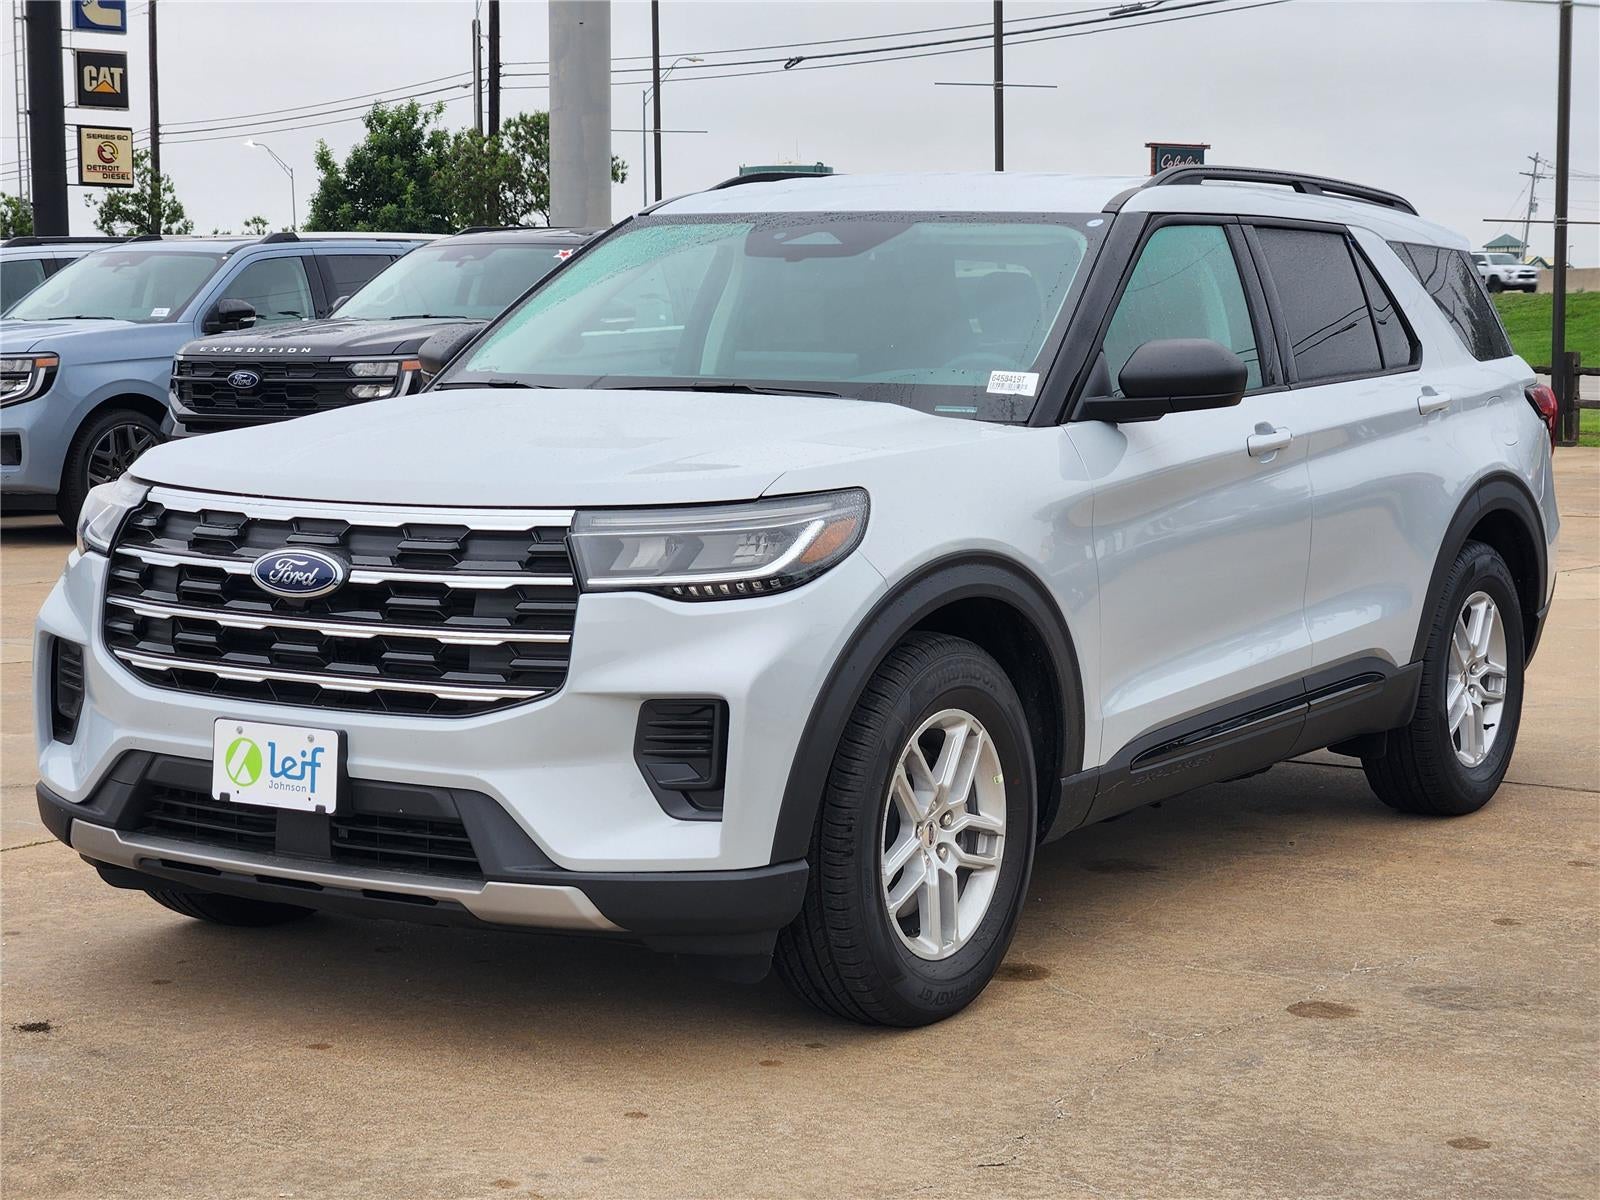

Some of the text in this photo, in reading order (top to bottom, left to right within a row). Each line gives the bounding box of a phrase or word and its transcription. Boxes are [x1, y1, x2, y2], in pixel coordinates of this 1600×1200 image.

[83, 65, 124, 95] CAT
[233, 373, 252, 386] Ford
[268, 558, 320, 586] Ford
[268, 780, 307, 793] Johnson
